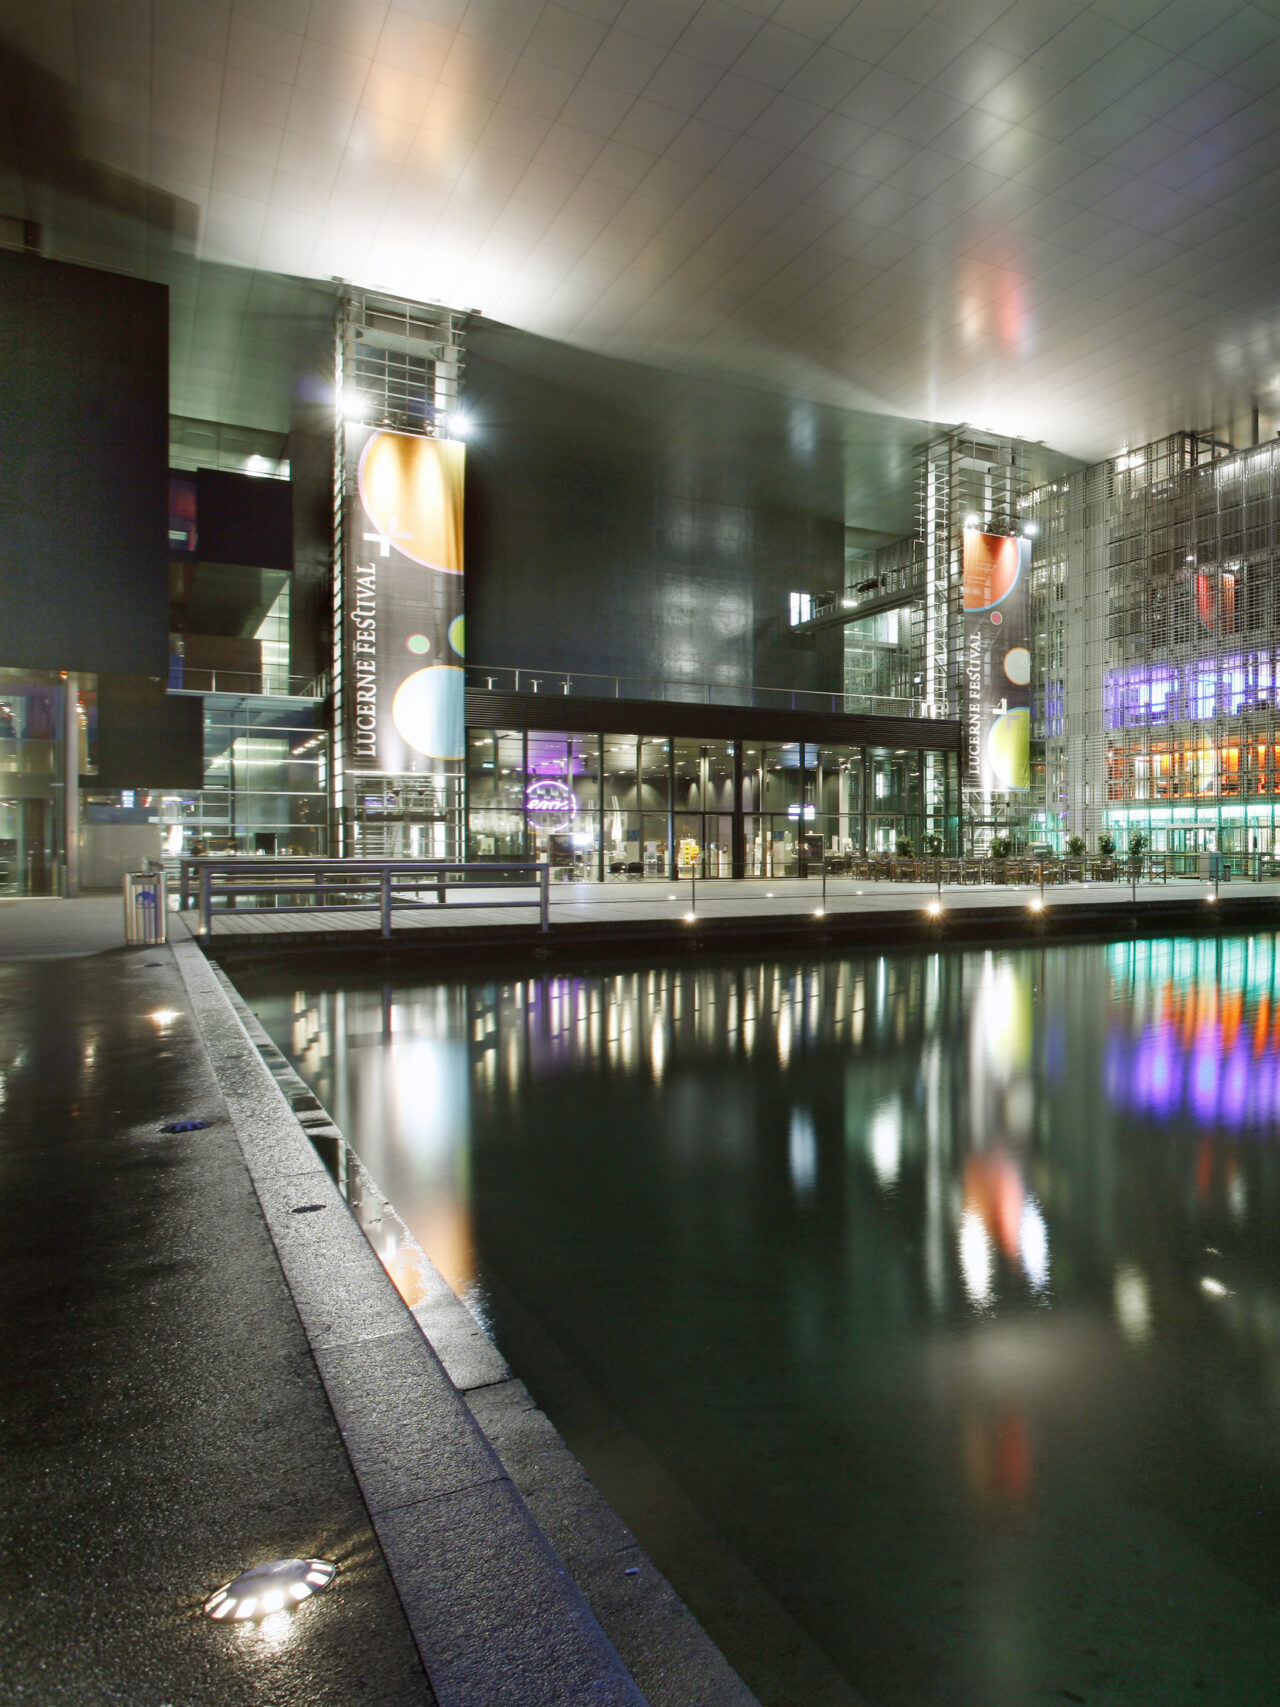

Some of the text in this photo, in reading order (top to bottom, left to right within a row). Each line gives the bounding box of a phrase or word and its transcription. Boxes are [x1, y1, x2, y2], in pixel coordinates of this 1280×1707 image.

[351, 562, 377, 757] LUCERNE FESTIVAL
[966, 631, 982, 776] LUCERNE FESTIVAL
